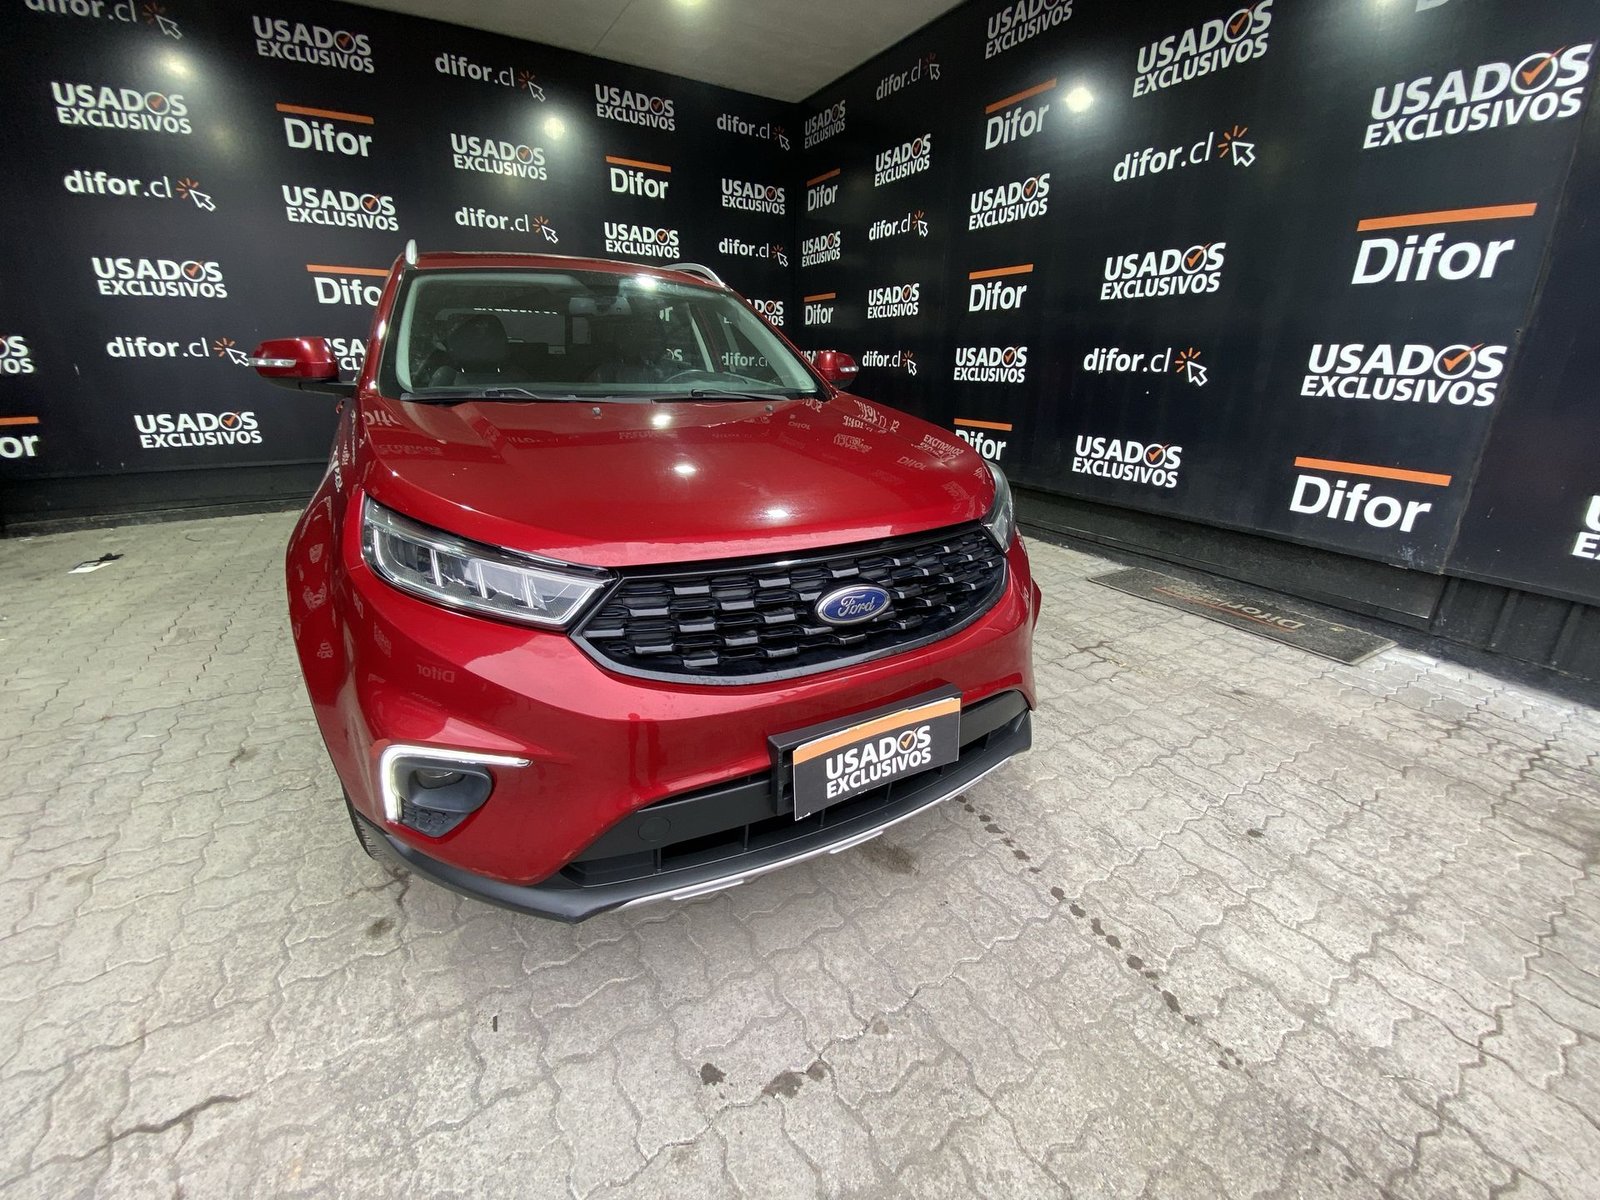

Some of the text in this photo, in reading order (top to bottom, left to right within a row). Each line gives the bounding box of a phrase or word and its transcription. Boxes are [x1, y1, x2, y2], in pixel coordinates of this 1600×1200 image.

[252, 16, 372, 56] USADOS
[985, 0, 1073, 60] EXCLUSIVOS
[1136, 0, 1273, 74] USADOS
[256, 39, 375, 73] EXCLUSIVOS
[435, 53, 514, 87] difor.cl
[1132, 33, 1269, 98] EXCLUSIVOS
[876, 59, 922, 100] difor.cl
[1370, 44, 1592, 120] USADOS
[51, 82, 188, 116] USADOS
[595, 84, 674, 117] USADOS
[56, 107, 192, 134] EXCLUSIVOS
[597, 103, 675, 131] EXCLUSIVOS
[716, 113, 770, 140] difor.cl
[804, 100, 845, 135] USADOS
[985, 104, 1050, 150] Difor
[1363, 87, 1583, 149] EXCLUSIVOS
[283, 118, 372, 156] Difor
[450, 133, 545, 165] USADOS
[804, 118, 845, 149] EXCLUSIVOS
[453, 154, 547, 181] EXCLUSIVOS
[875, 134, 931, 172] USADOS
[1113, 132, 1214, 182] difor.cl
[64, 170, 172, 198] difor.cl
[610, 168, 668, 199] Difor
[874, 155, 930, 187] EXCLUSIVOS
[282, 185, 396, 216] USADOS
[721, 179, 785, 202] USADOS
[722, 194, 785, 215] EXCLUSIVOS
[807, 184, 838, 212] Difor
[970, 173, 1050, 213] USADOS
[286, 206, 399, 231] EXCLUSIVOS
[455, 207, 529, 233] difor.cl
[868, 213, 911, 241] difor.cl
[968, 198, 1048, 230] EXCLUSIVOS
[604, 222, 679, 246] USADOS
[606, 239, 680, 259] EXCLUSIVOS
[718, 238, 769, 258] difor.cl
[802, 231, 840, 255] USADOS
[92, 257, 223, 283] USADOS
[802, 248, 840, 267] EXCLUSIVOS
[1104, 242, 1226, 282] USADOS
[1351, 233, 1514, 284] Difor
[98, 279, 227, 298] EXCLUSIVOS
[314, 276, 383, 306] Difo
[868, 283, 919, 306] USADOS
[969, 281, 1027, 312] Difor
[1100, 271, 1220, 300] EXCLUSIVOS
[805, 305, 833, 325] Difor
[867, 301, 918, 319] EXCLUSIVOS
[106, 337, 209, 358] difor.cl
[862, 350, 900, 368] difor.cl
[955, 346, 1027, 368] USADOS
[1083, 348, 1172, 373] difor.cl
[1308, 343, 1507, 380] USADOS
[953, 366, 1025, 383] EXCLUSIVOS
[1300, 376, 1498, 407] EXCLUSIVOS
[134, 411, 258, 433] USADOS
[140, 431, 262, 448] EXCLUSIVOS
[1075, 435, 1182, 470] USADOS
[1072, 457, 1177, 488] EXCLUSIVOS
[1289, 475, 1431, 533] Difor
[837, 594, 875, 616] Ford
[826, 725, 931, 780] USADOS
[827, 749, 931, 799] EXCLUSIVOS
